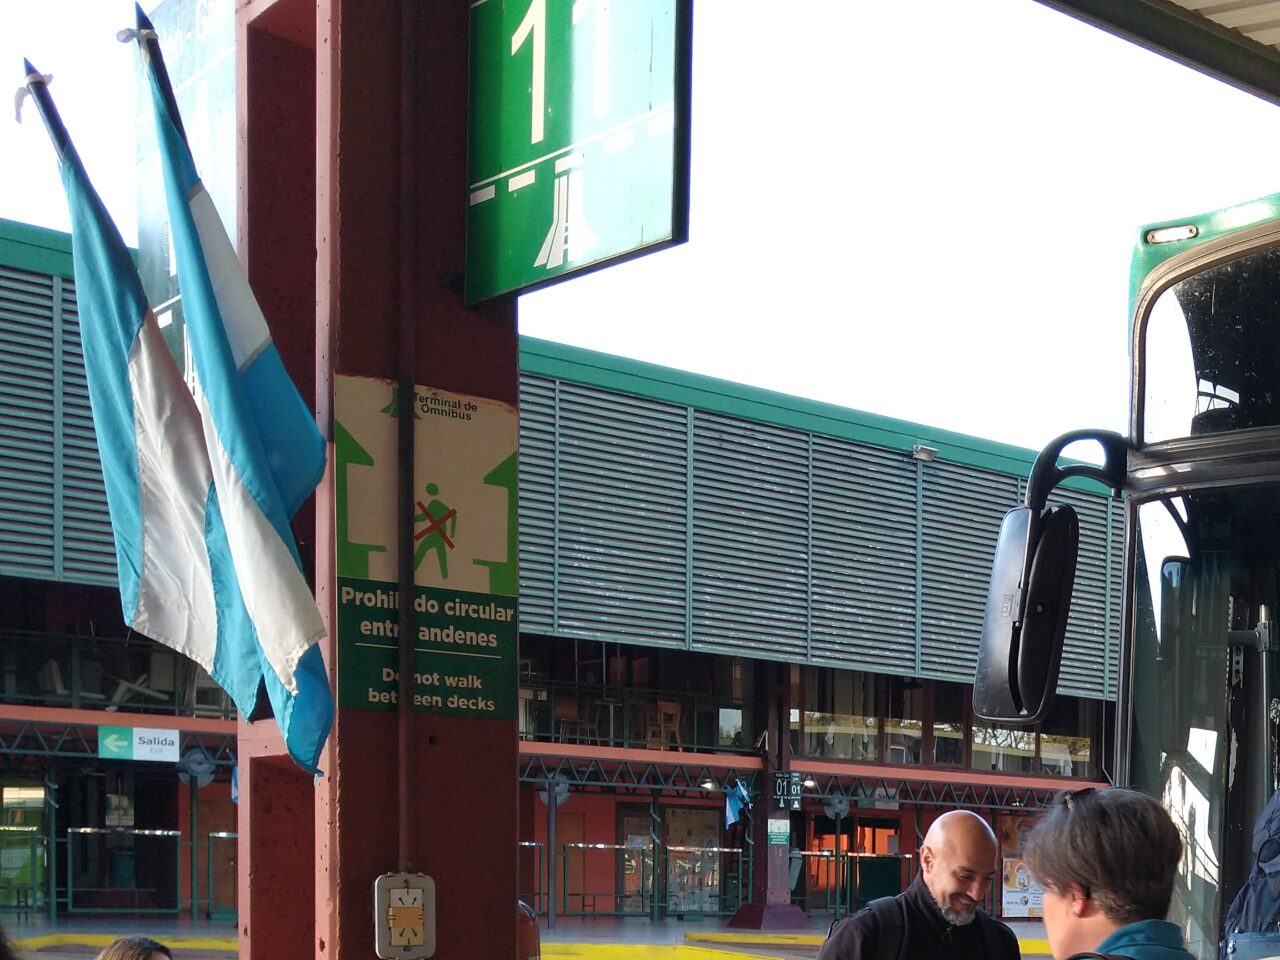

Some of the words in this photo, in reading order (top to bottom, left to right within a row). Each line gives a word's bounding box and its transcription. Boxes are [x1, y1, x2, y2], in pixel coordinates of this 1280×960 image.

[414, 392, 461, 410] Terminal
[464, 401, 478, 412] de
[421, 403, 472, 421] Omnibus
[341, 586, 439, 614] Prohido
[444, 598, 514, 622] circular
[418, 625, 498, 648] andenes
[414, 672, 440, 686] not
[444, 674, 483, 689] walk
[368, 687, 442, 707] beteen
[447, 694, 496, 711] decks
[138, 736, 175, 747] Salida
[776, 779, 787, 795] 01
